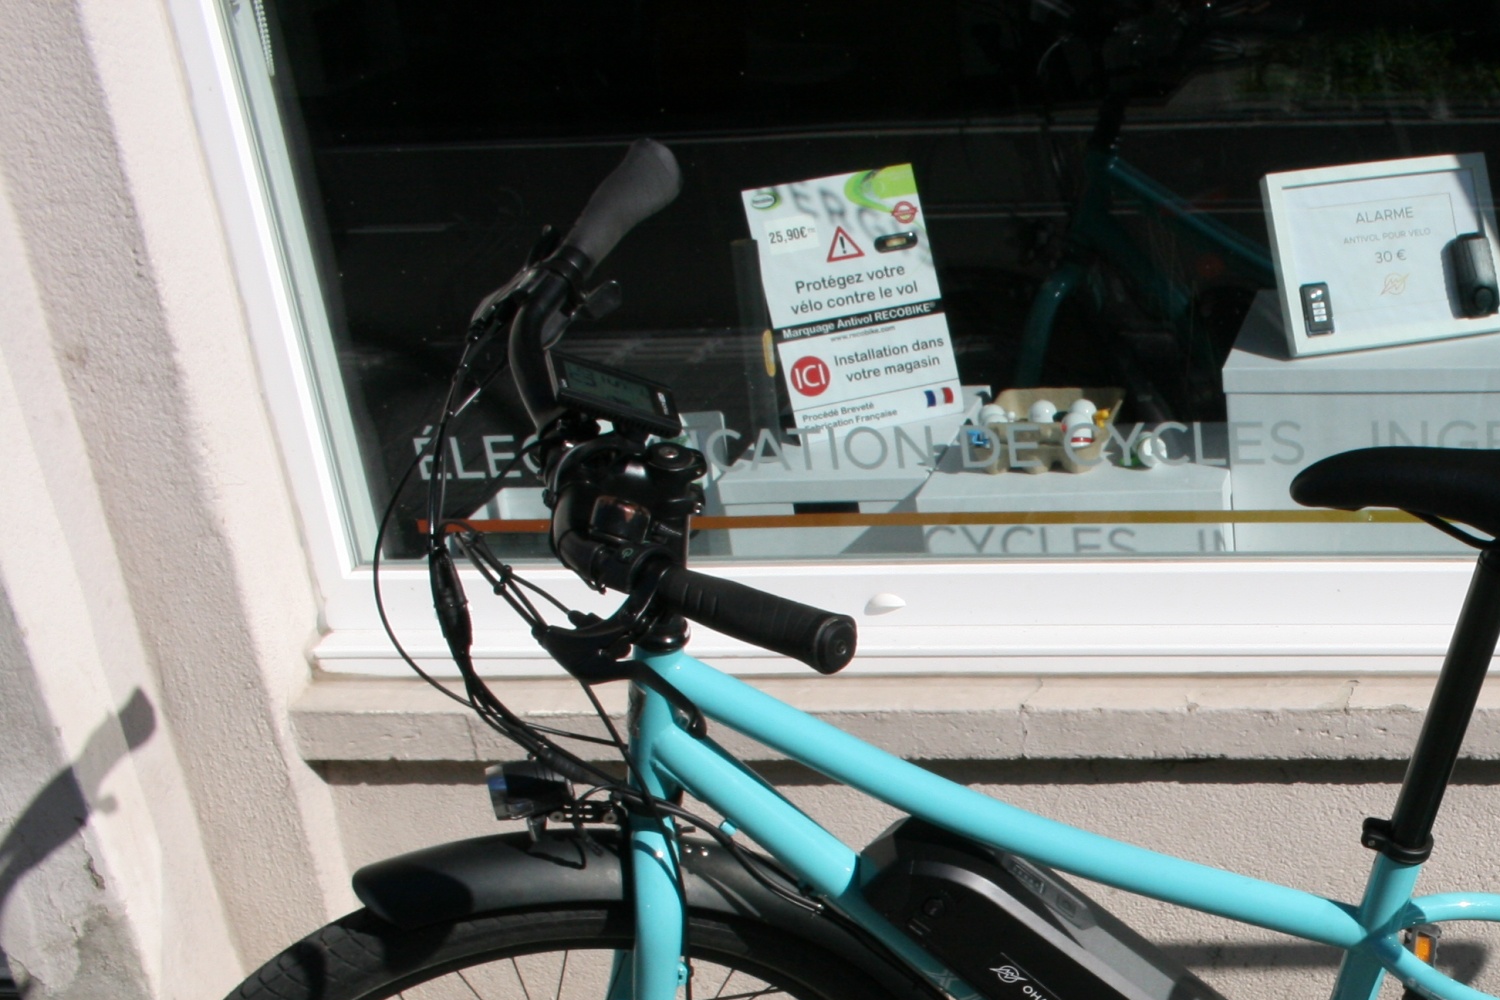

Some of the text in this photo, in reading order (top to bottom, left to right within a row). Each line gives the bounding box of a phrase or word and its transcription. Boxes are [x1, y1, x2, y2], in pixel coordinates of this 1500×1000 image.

[1355, 206, 1414, 225] ALARME
[768, 226, 808, 245] 25,90€
[1343, 232, 1381, 245] ANTIVOL
[1382, 230, 1406, 241] POUR
[1374, 249, 1407, 264] 30 €
[795, 265, 905, 294] Protégez votre
[791, 281, 919, 315] vélo contre le vol
[782, 320, 836, 340] Marquage
[837, 313, 873, 329] Antivol
[834, 336, 944, 367] Installation dans
[794, 363, 827, 390] ICI
[846, 354, 941, 383] votre magasin
[802, 401, 874, 422] Procédé Breveté
[855, 409, 898, 426] Française
[960, 424, 1042, 468] DE
[1063, 420, 1305, 469] CYCLES
